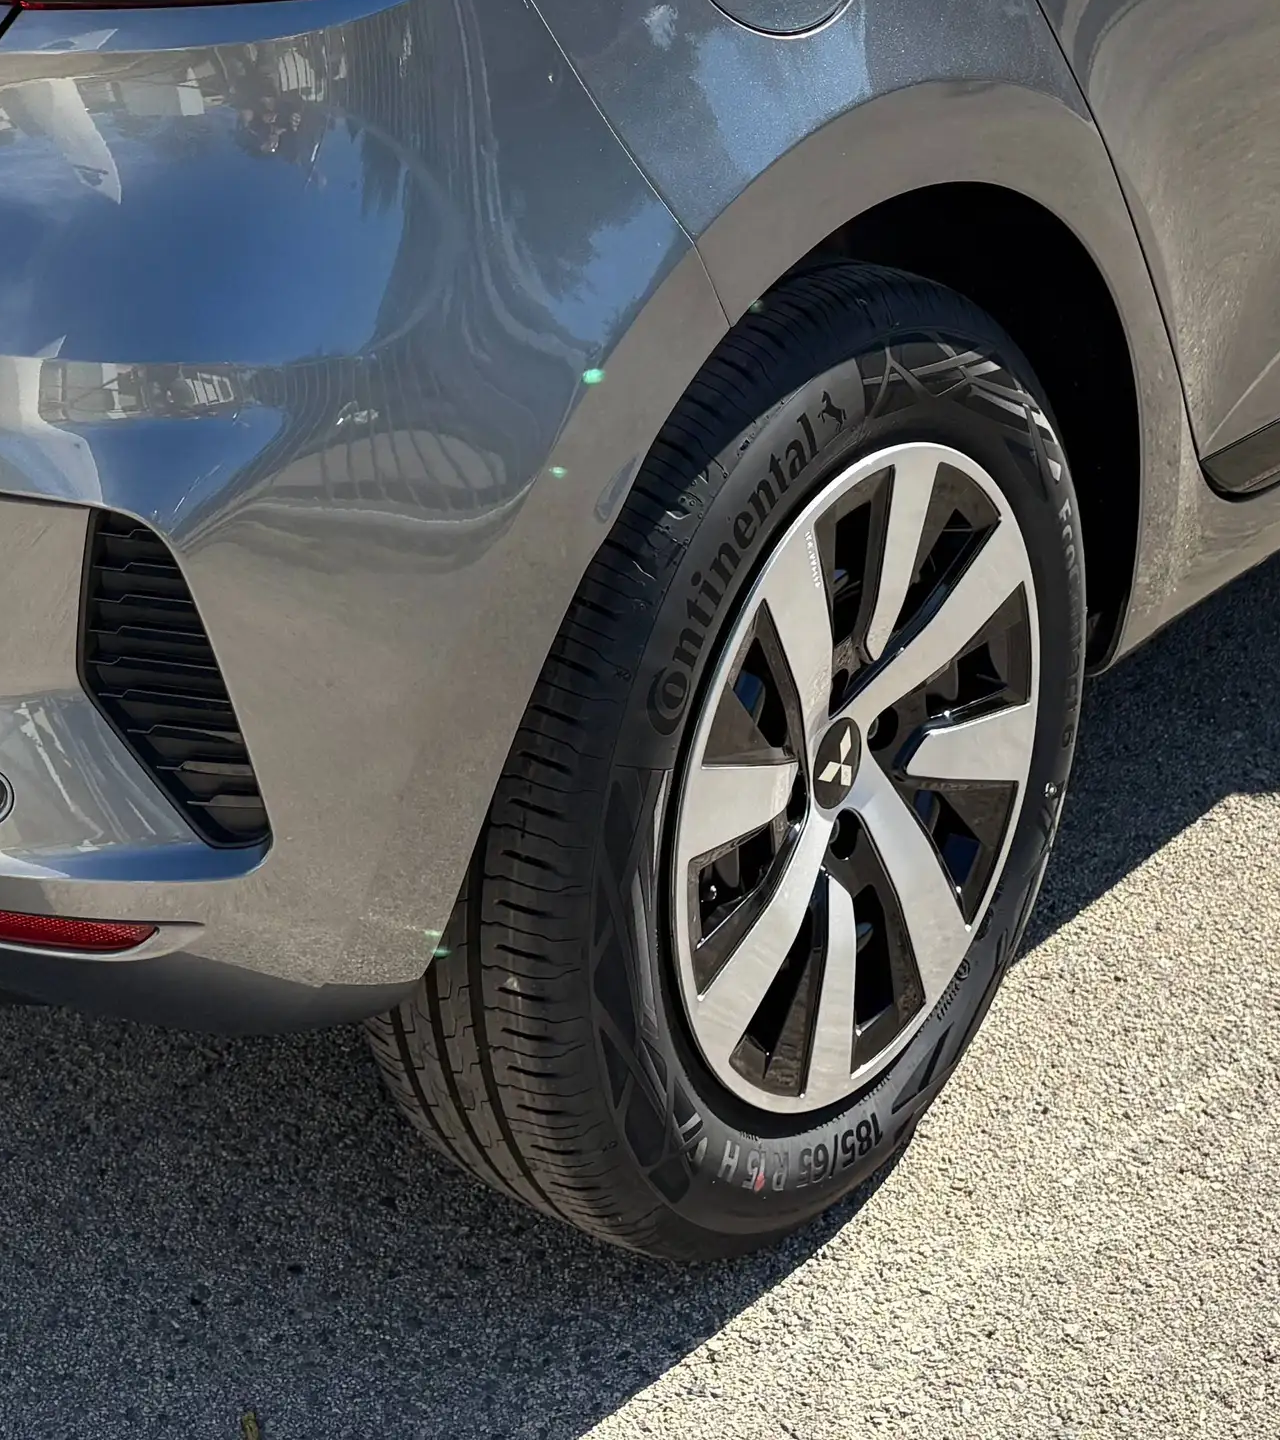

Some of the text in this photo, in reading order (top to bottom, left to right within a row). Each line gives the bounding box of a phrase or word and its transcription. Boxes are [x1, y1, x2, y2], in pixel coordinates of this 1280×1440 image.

[646, 410, 819, 737] Continental
[717, 1139, 741, 1184] H
[796, 1112, 884, 1189] 185/65
